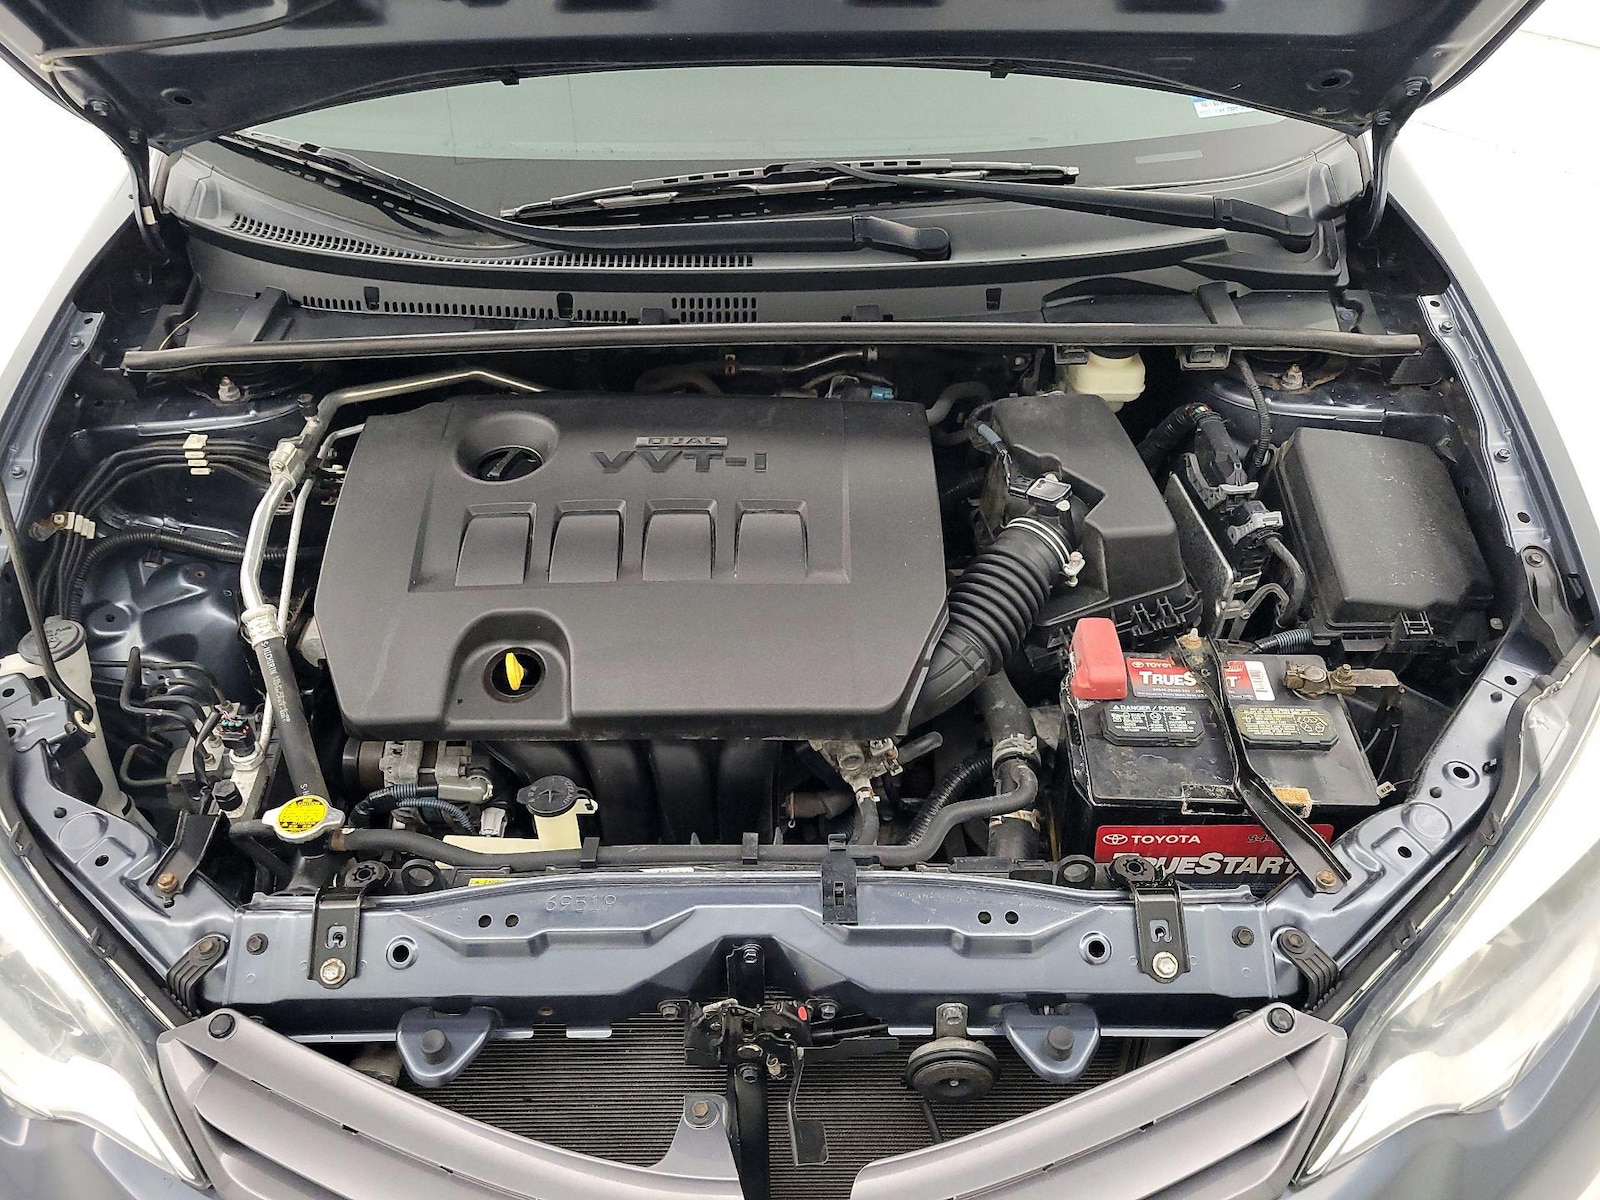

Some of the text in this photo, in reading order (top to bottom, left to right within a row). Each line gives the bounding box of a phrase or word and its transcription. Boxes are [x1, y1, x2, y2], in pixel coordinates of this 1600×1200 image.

[647, 437, 720, 445] DUAL
[1145, 661, 1173, 669] TOYOT
[1131, 834, 1201, 844] TOYOTA
[545, 894, 617, 911] 69519
